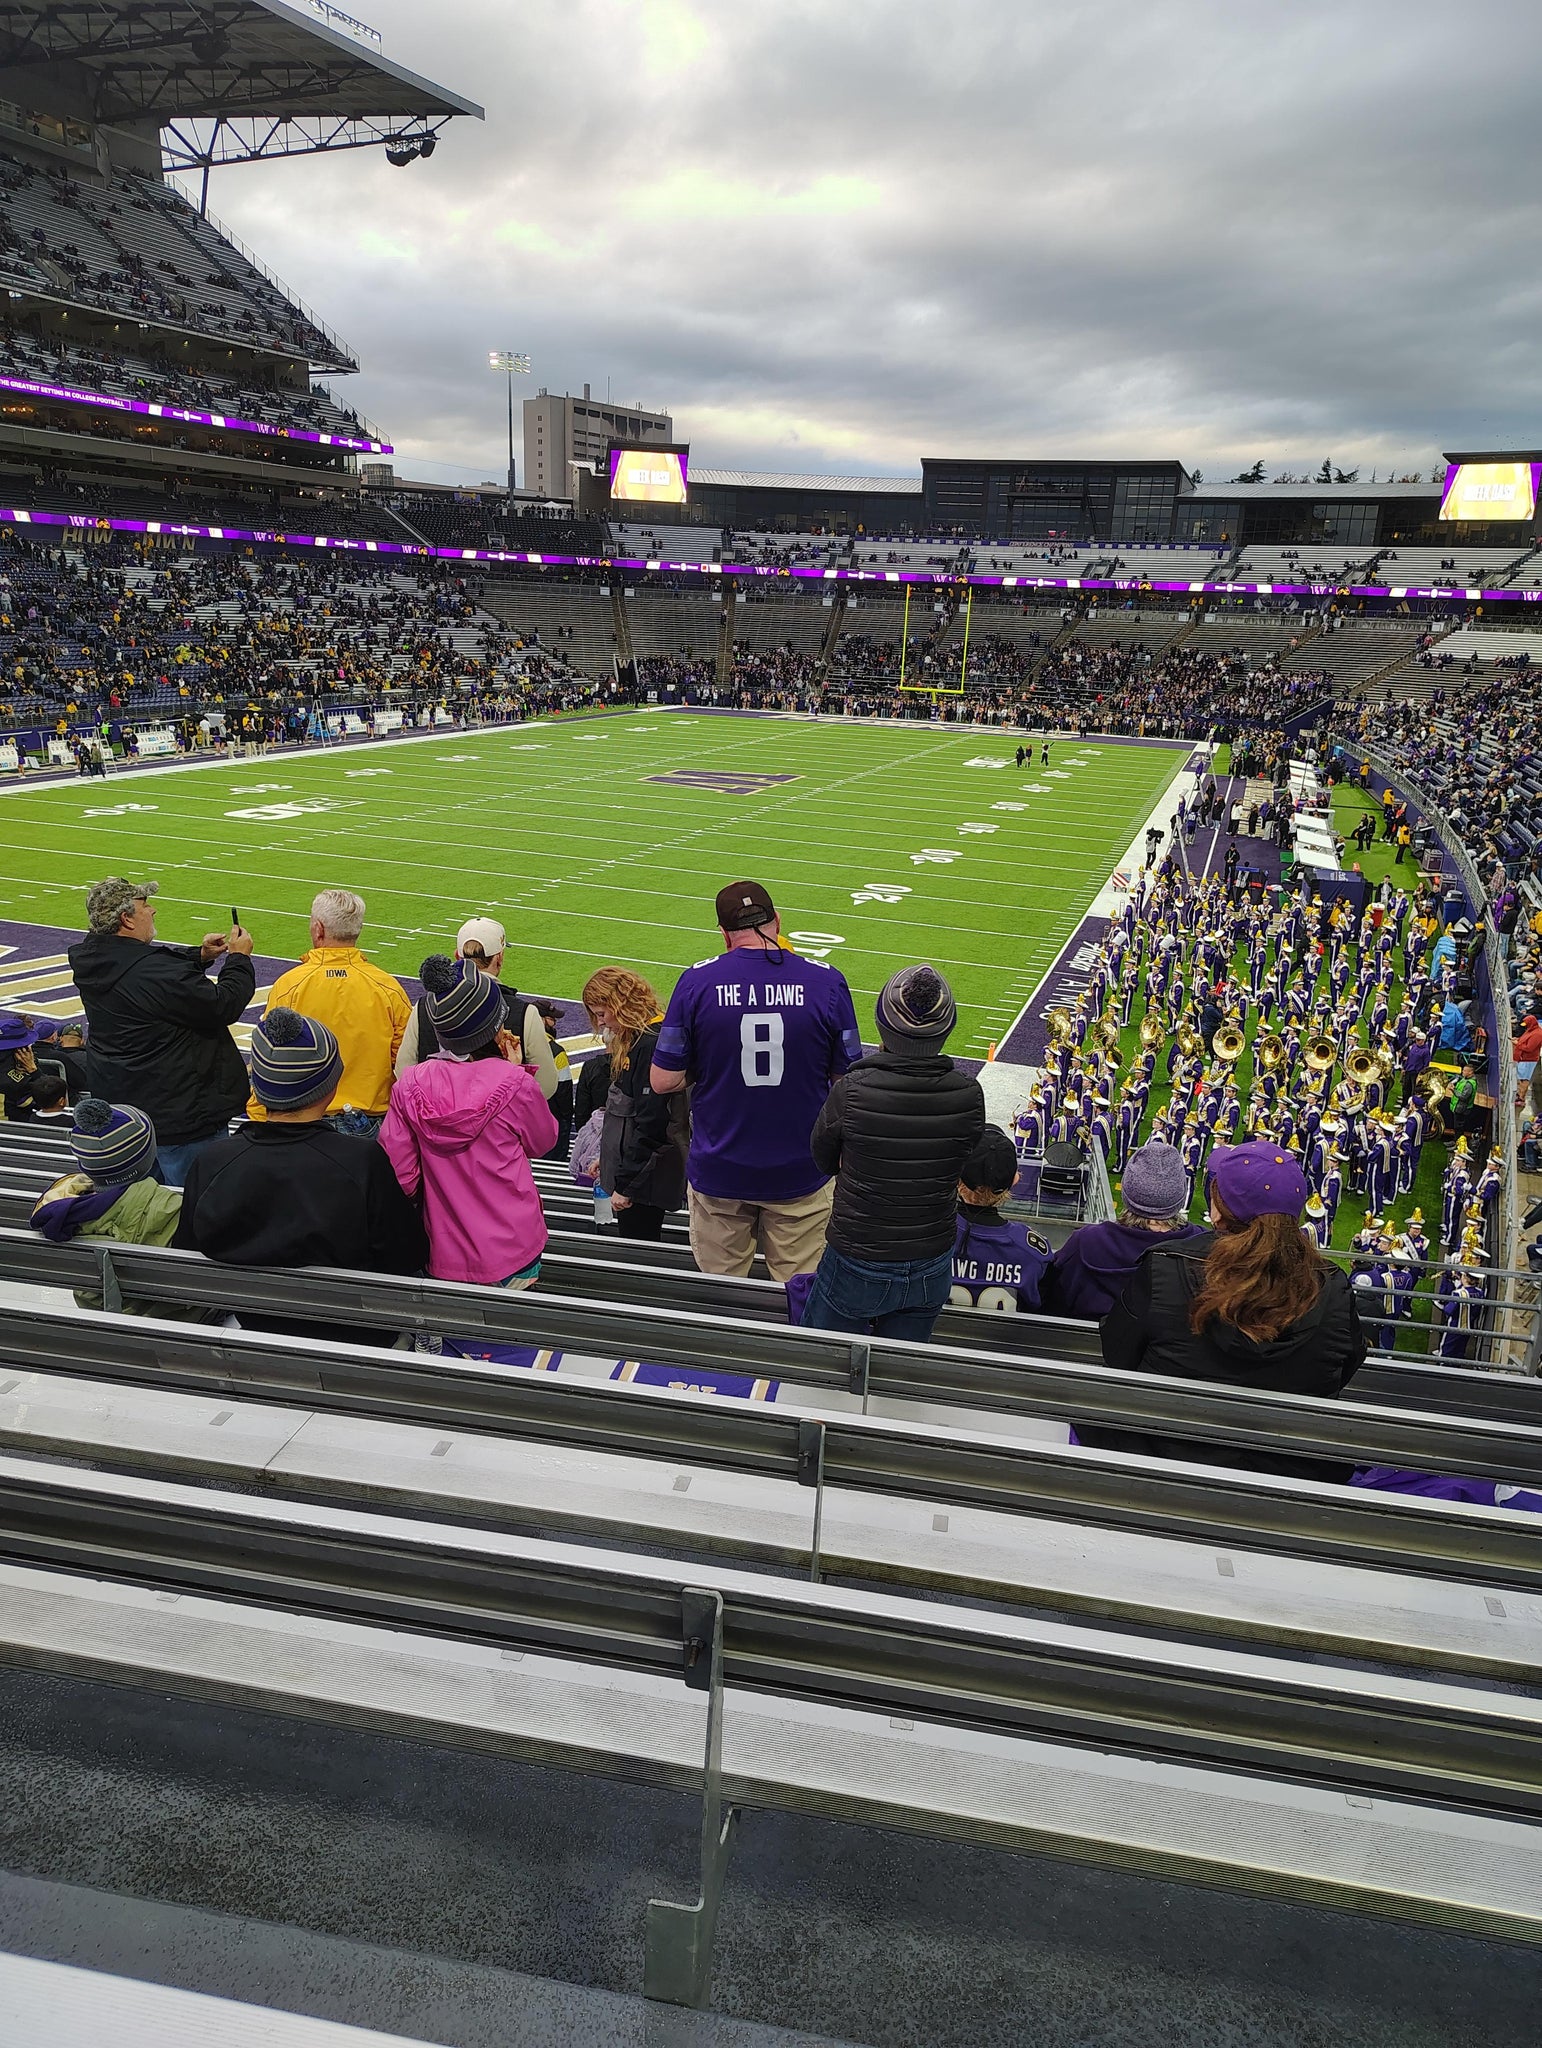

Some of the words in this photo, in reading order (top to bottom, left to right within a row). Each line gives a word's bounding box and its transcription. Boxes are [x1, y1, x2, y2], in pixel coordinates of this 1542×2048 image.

[10, 381, 40, 392] GREATEST
[40, 387, 64, 396] SETTING
[71, 392, 97, 402] COLLEGE
[97, 397, 125, 407] FOOTBALL
[325, 969, 348, 978] IOWA
[715, 984, 742, 1007] THE
[747, 984, 758, 1006] A
[765, 984, 804, 1007] DAWG
[740, 1012, 785, 1087] 8
[1026, 1230, 1049, 1256] 8
[951, 1257, 978, 1280] WG
[985, 1262, 1022, 1284] BOSS
